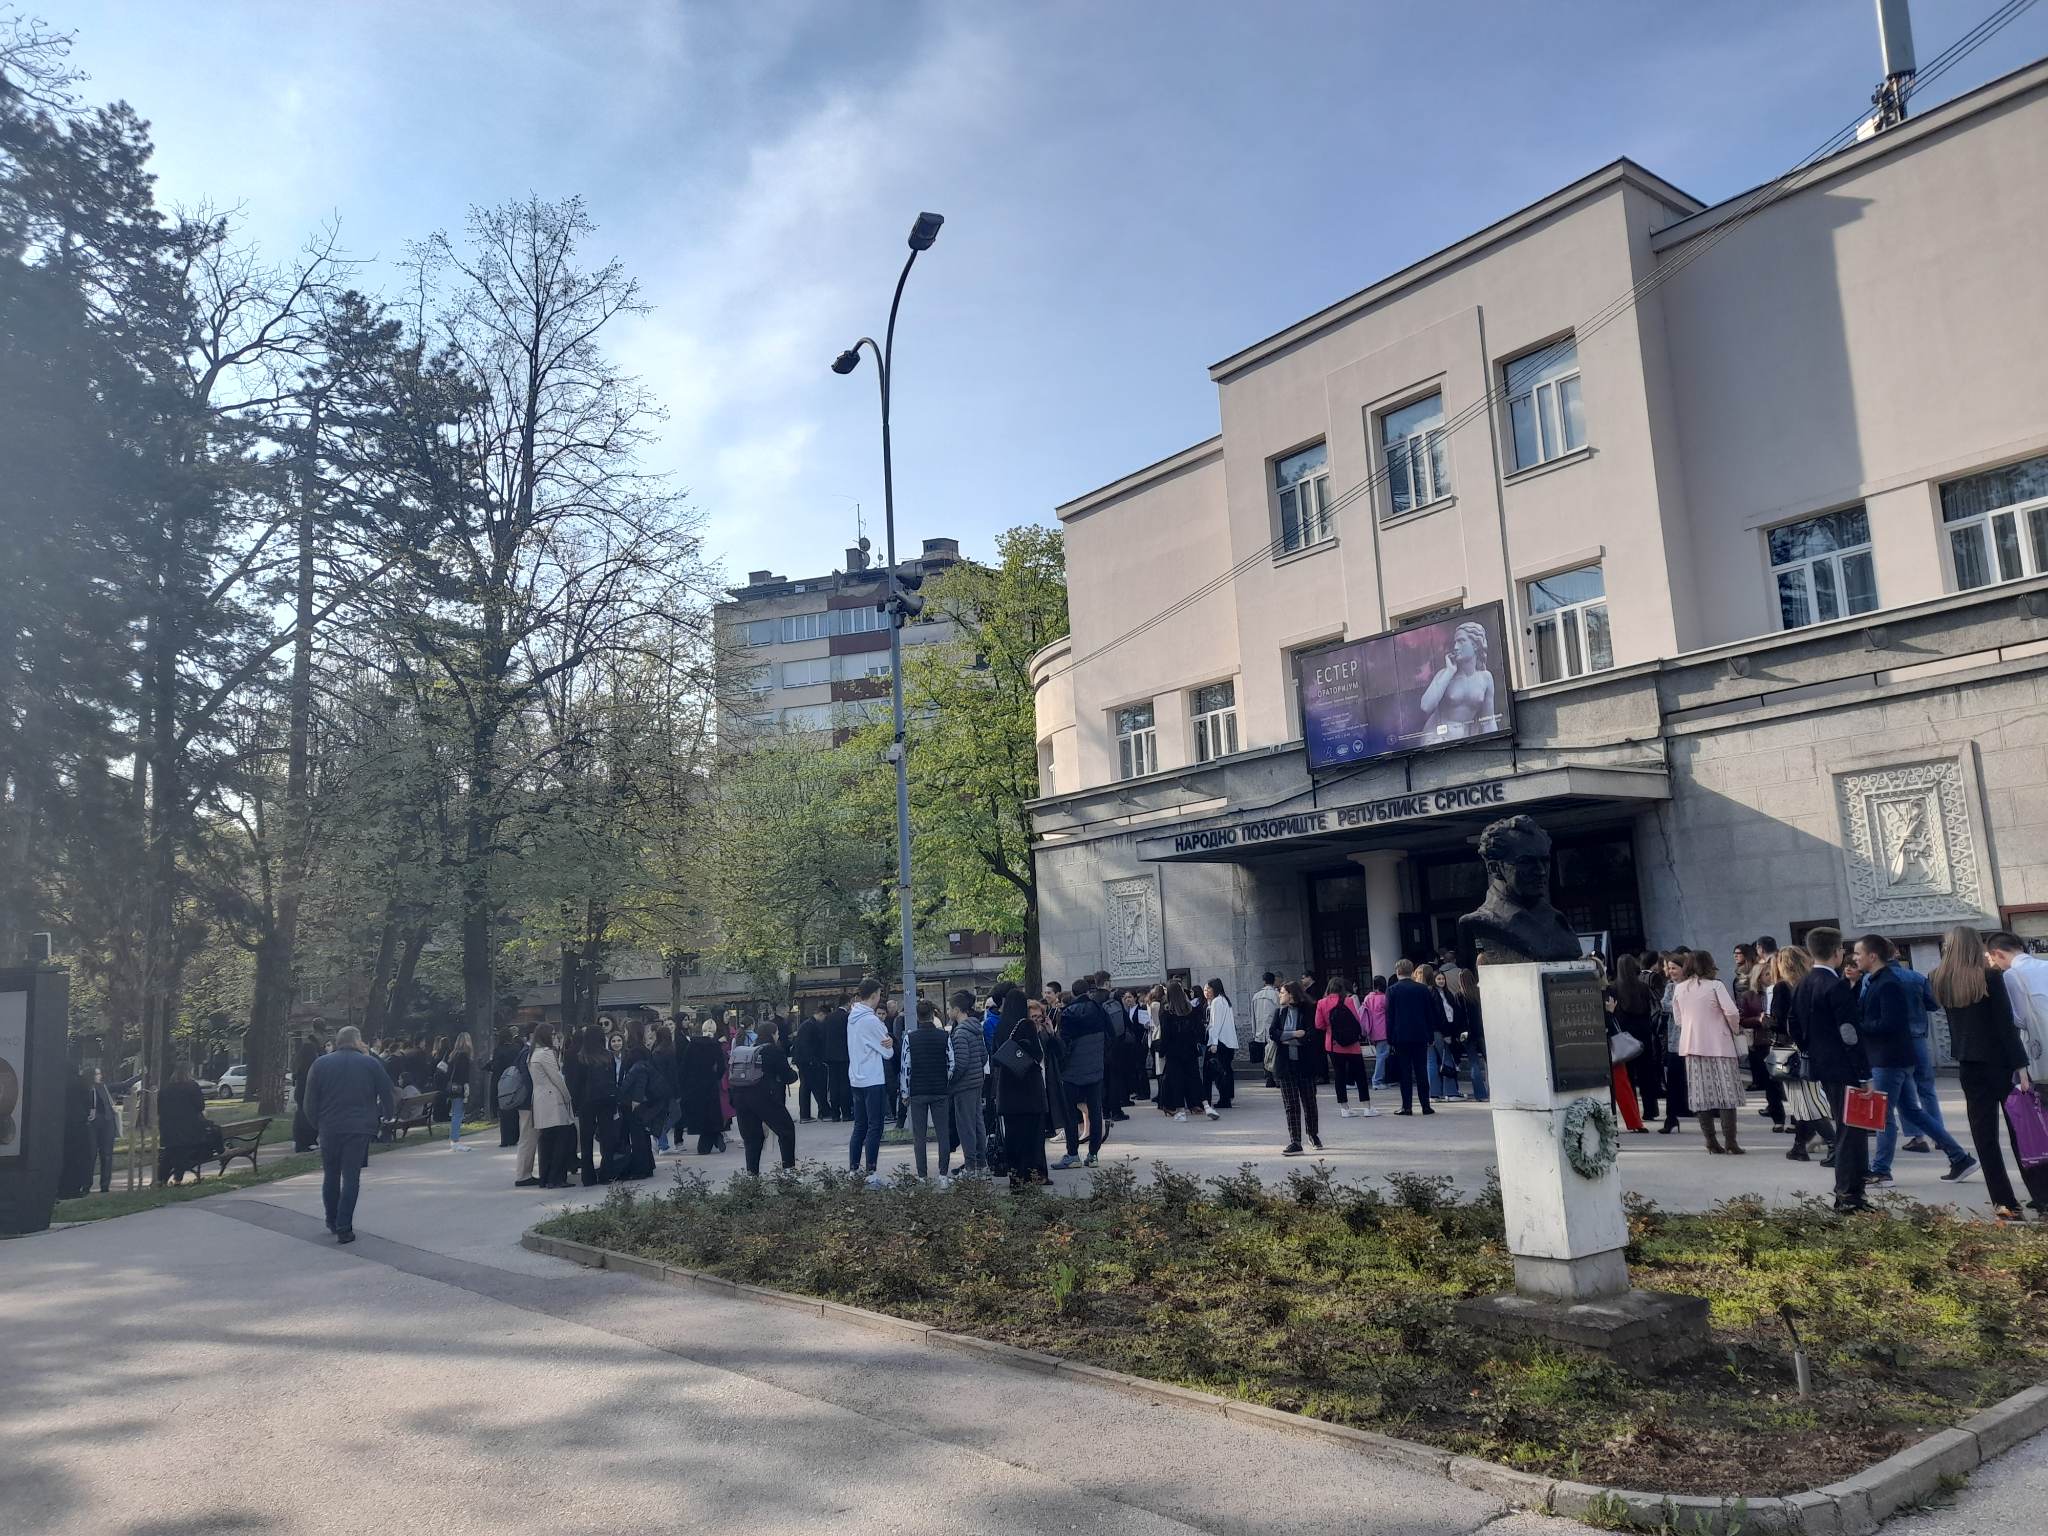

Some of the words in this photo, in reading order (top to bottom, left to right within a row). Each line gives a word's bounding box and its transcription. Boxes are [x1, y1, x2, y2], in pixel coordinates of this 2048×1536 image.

[1316, 660, 1358, 685] ЕСТЕР
[1174, 829, 1237, 852] НАРОДНО
[1242, 813, 1328, 842] ПОЗОРИШТЕ
[1337, 795, 1429, 828] РЕПУБЛИКЕ
[1434, 782, 1505, 812] СРПСКЕ
